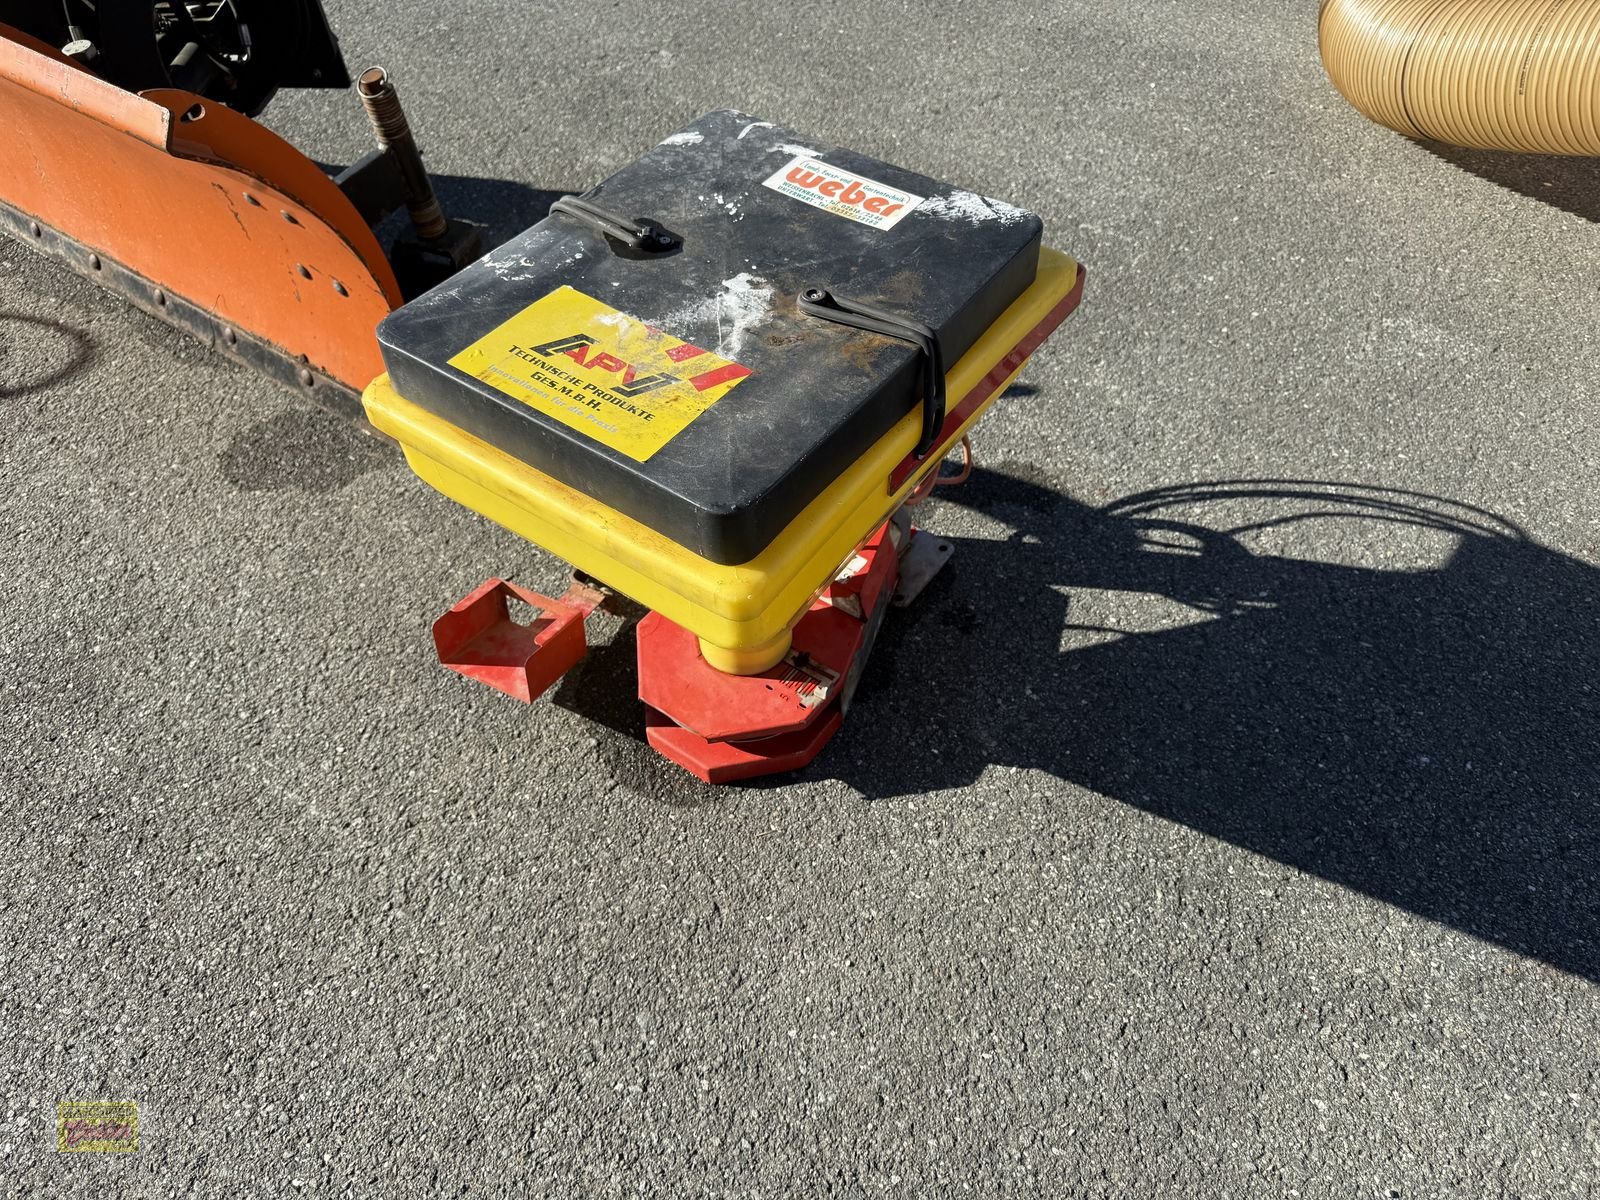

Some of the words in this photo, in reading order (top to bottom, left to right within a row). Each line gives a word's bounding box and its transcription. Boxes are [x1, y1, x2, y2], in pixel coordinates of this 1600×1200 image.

[786, 167, 904, 217] weber
[862, 185, 905, 203] Gartentechnik
[508, 344, 584, 387] TECHNISCHE
[582, 383, 656, 422] PRODUKTE
[567, 405, 585, 416] die
[585, 413, 619, 433] Praxis
